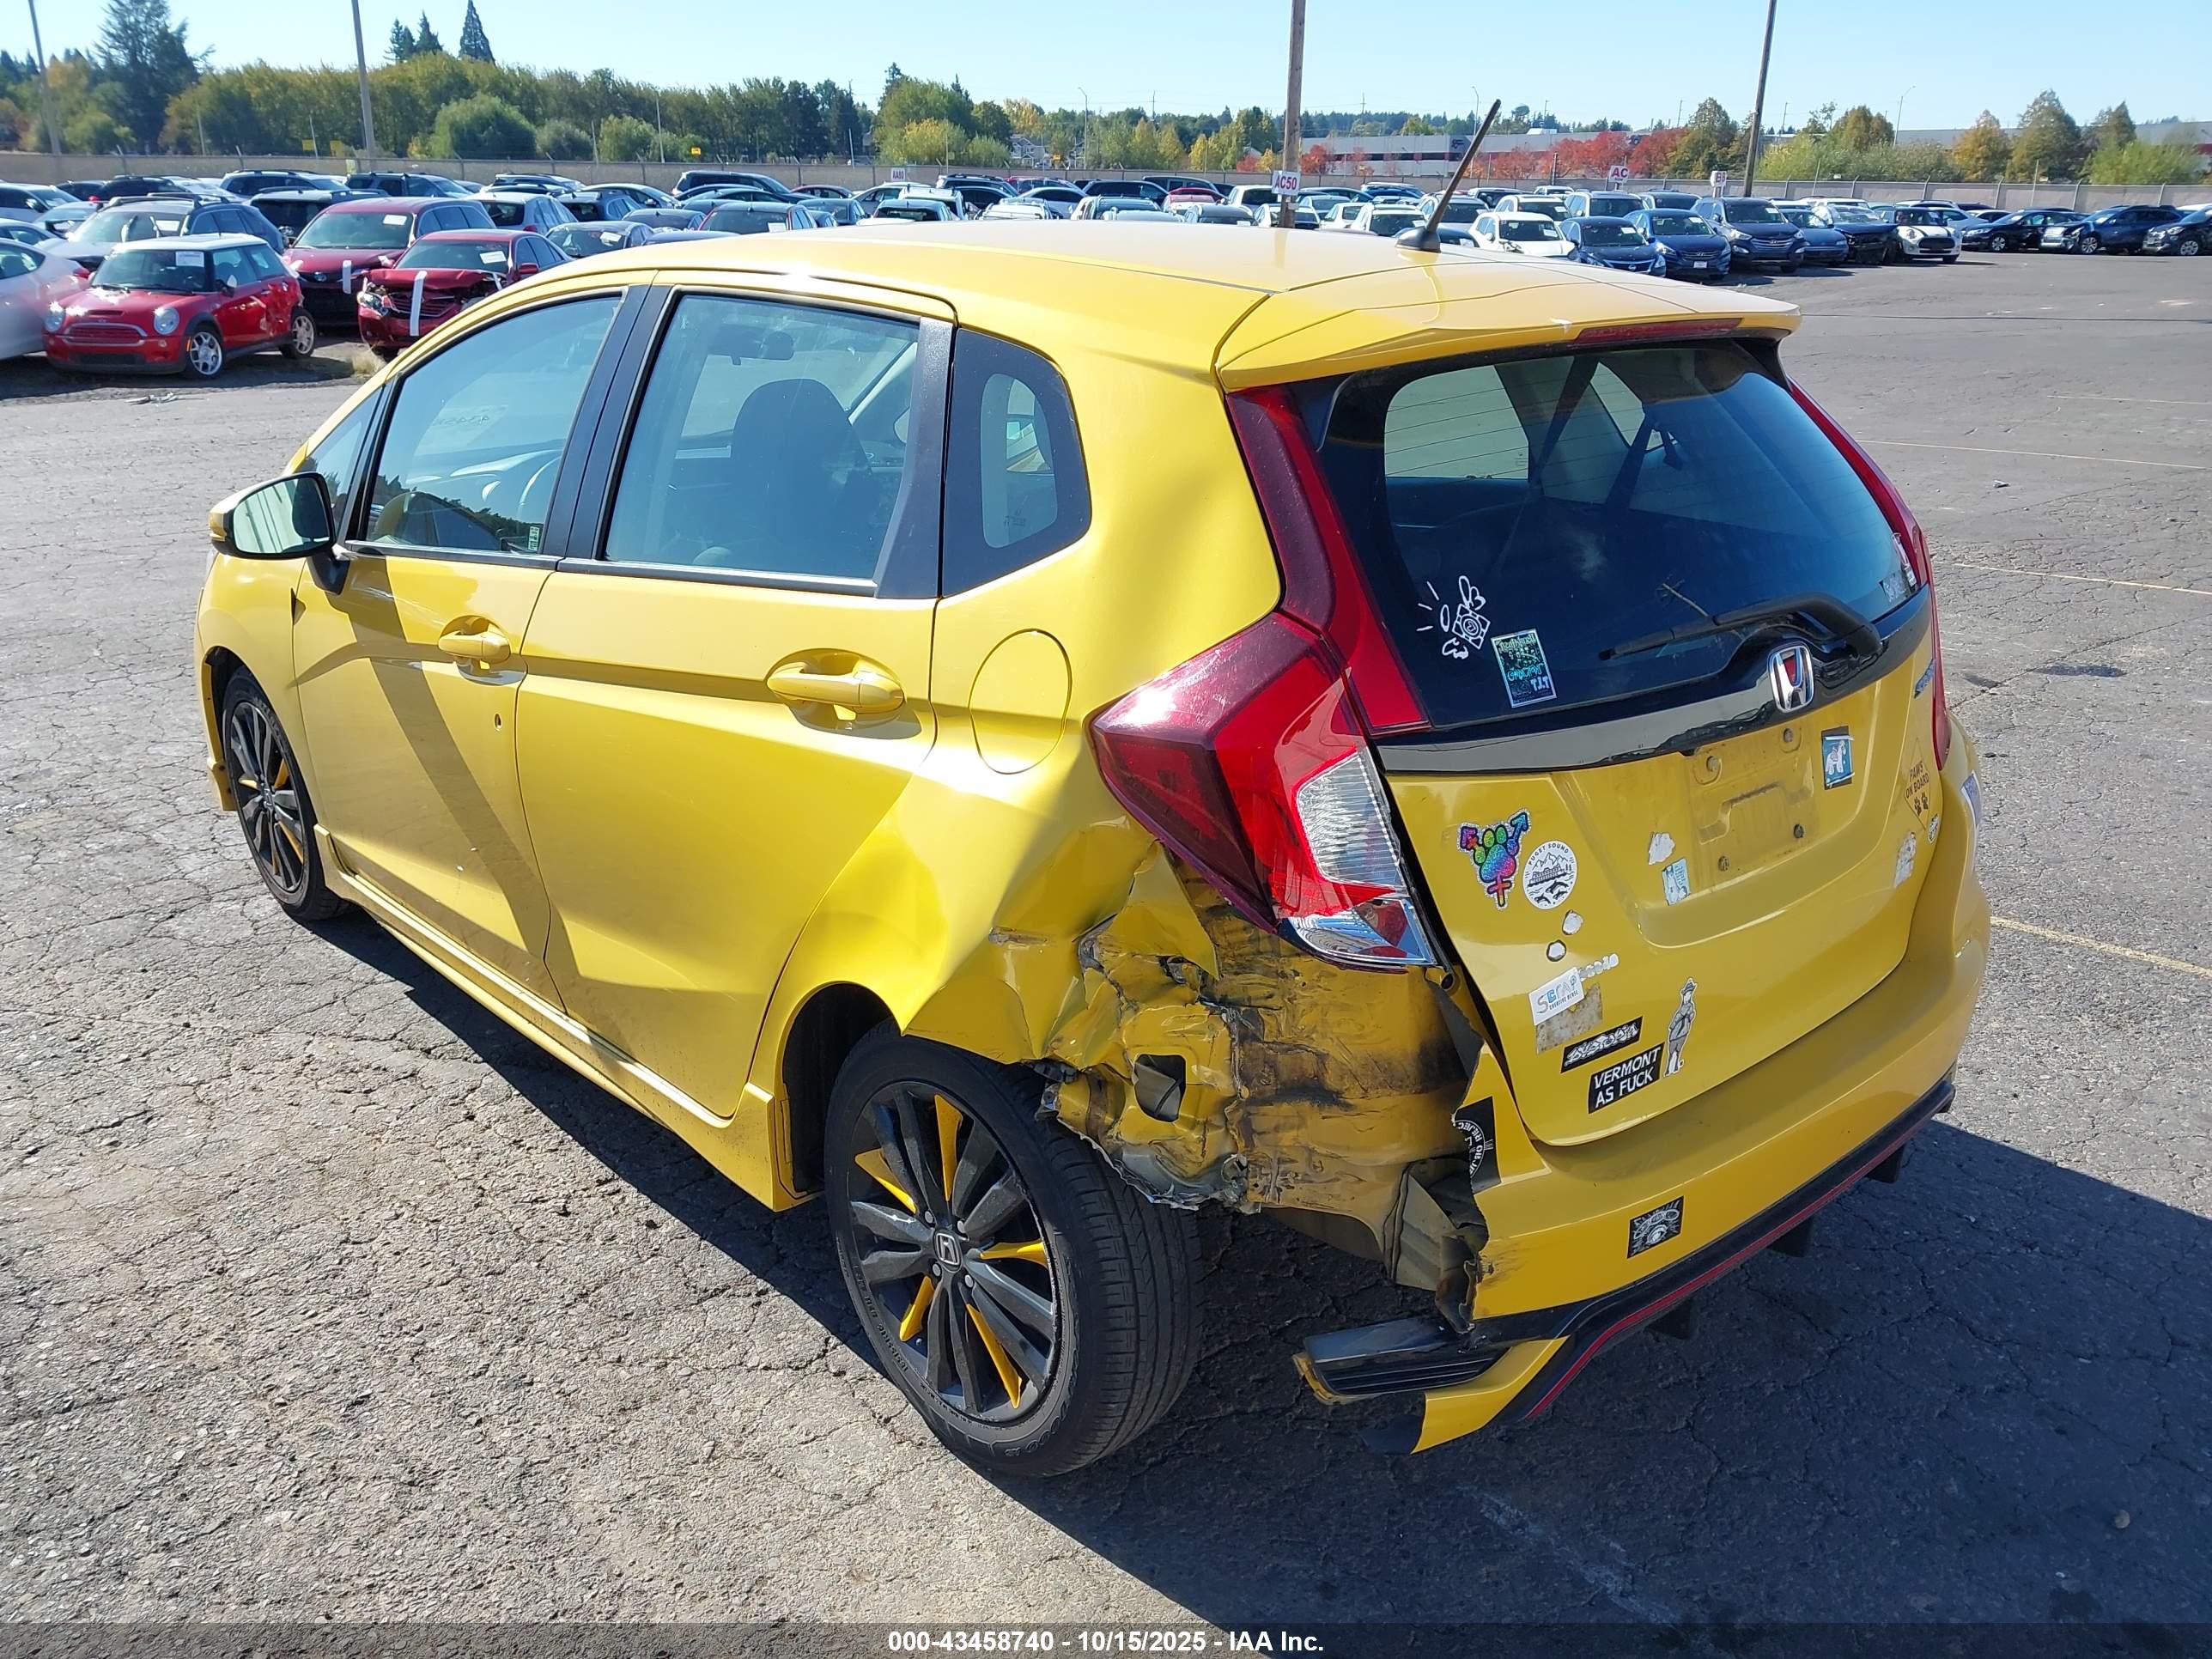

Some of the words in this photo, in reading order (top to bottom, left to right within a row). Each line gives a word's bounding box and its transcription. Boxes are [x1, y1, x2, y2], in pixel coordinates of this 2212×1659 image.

[1274, 175, 1297, 190] AC50
[1611, 167, 1629, 178] AC
[1909, 763, 1923, 782] PAWS
[1905, 786, 1913, 799] ON
[1913, 773, 1929, 793] BOARD
[1528, 846, 1547, 866] PUGET
[1548, 842, 1569, 854] SOUND
[1593, 1047, 1662, 1089] VERMONT
[1595, 1085, 1614, 1109] AS
[1619, 1066, 1655, 1097] FUCK
